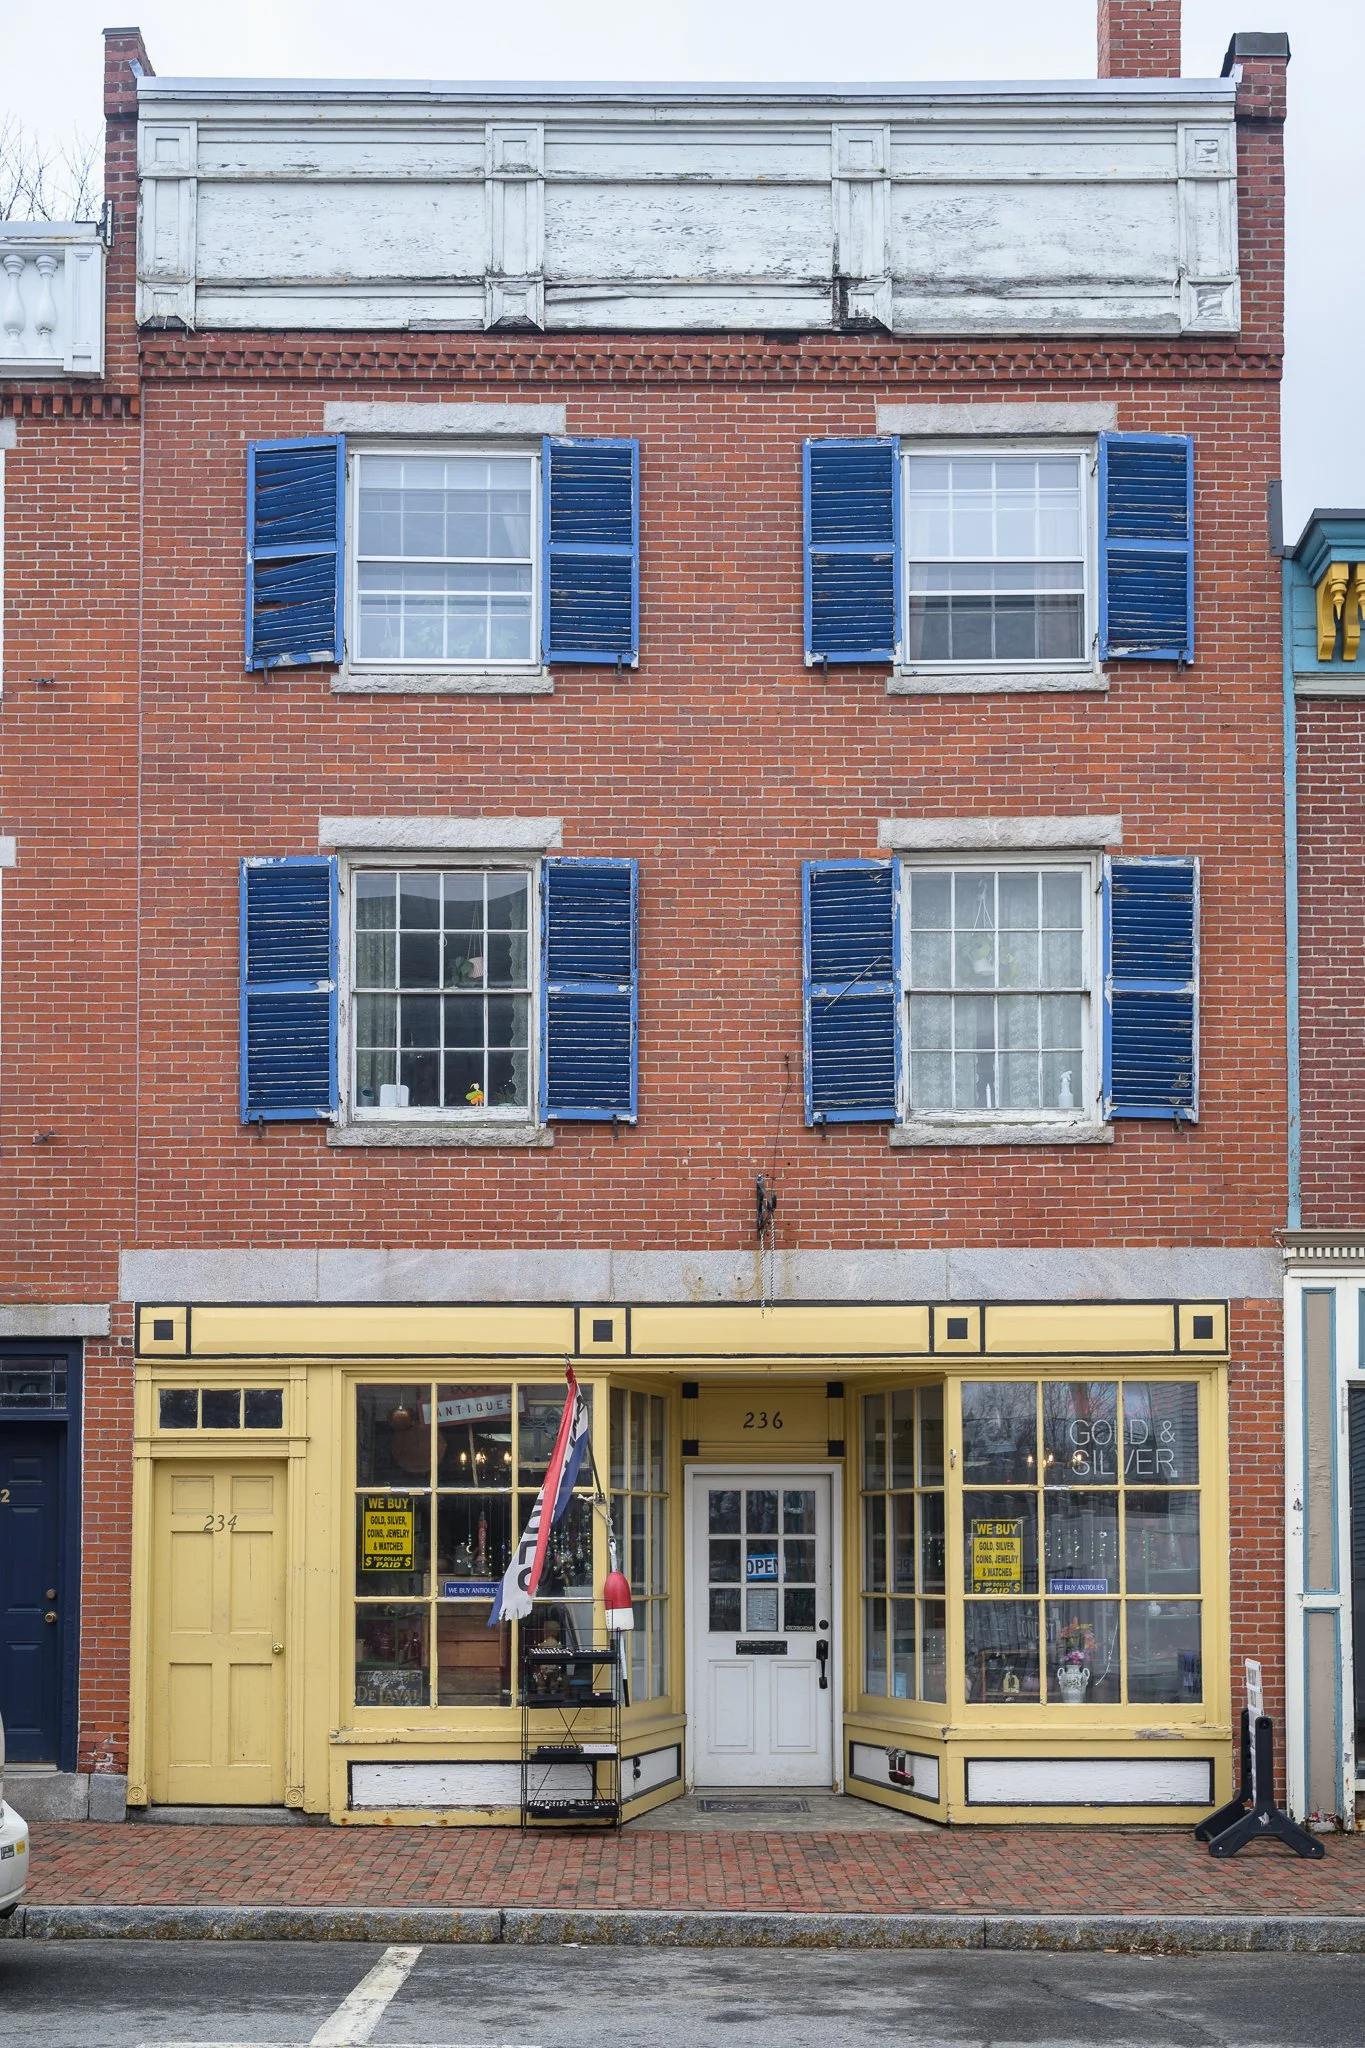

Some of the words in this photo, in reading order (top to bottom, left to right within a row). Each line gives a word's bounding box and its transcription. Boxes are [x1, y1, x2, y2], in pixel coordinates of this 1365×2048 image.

[743, 1411, 783, 1429] 236
[1069, 1419, 1148, 1445] GOLD
[1160, 1420, 1176, 1443] &
[1071, 1448, 1175, 1475] SILVER
[368, 1498, 385, 1509] WE
[387, 1498, 409, 1509] BUY
[203, 1514, 237, 1533] 234
[370, 1516, 386, 1526] GOLD,
[387, 1516, 407, 1526] SILVER,
[367, 1529, 385, 1539] COINS,
[386, 1529, 410, 1538] JEWELRY
[977, 1523, 993, 1535] WE
[995, 1523, 1017, 1535] BUY
[378, 1542, 404, 1551] WATCHES
[979, 1542, 994, 1552] GOLD,
[995, 1542, 1016, 1552] SILVER,
[365, 1557, 373, 1566] $
[404, 1557, 412, 1567] $
[976, 1555, 993, 1565] COINS,
[994, 1555, 1018, 1564] JEWELRY
[988, 1568, 1013, 1577] WATCHES
[974, 1583, 981, 1592] $
[1013, 1583, 1020, 1592] $
